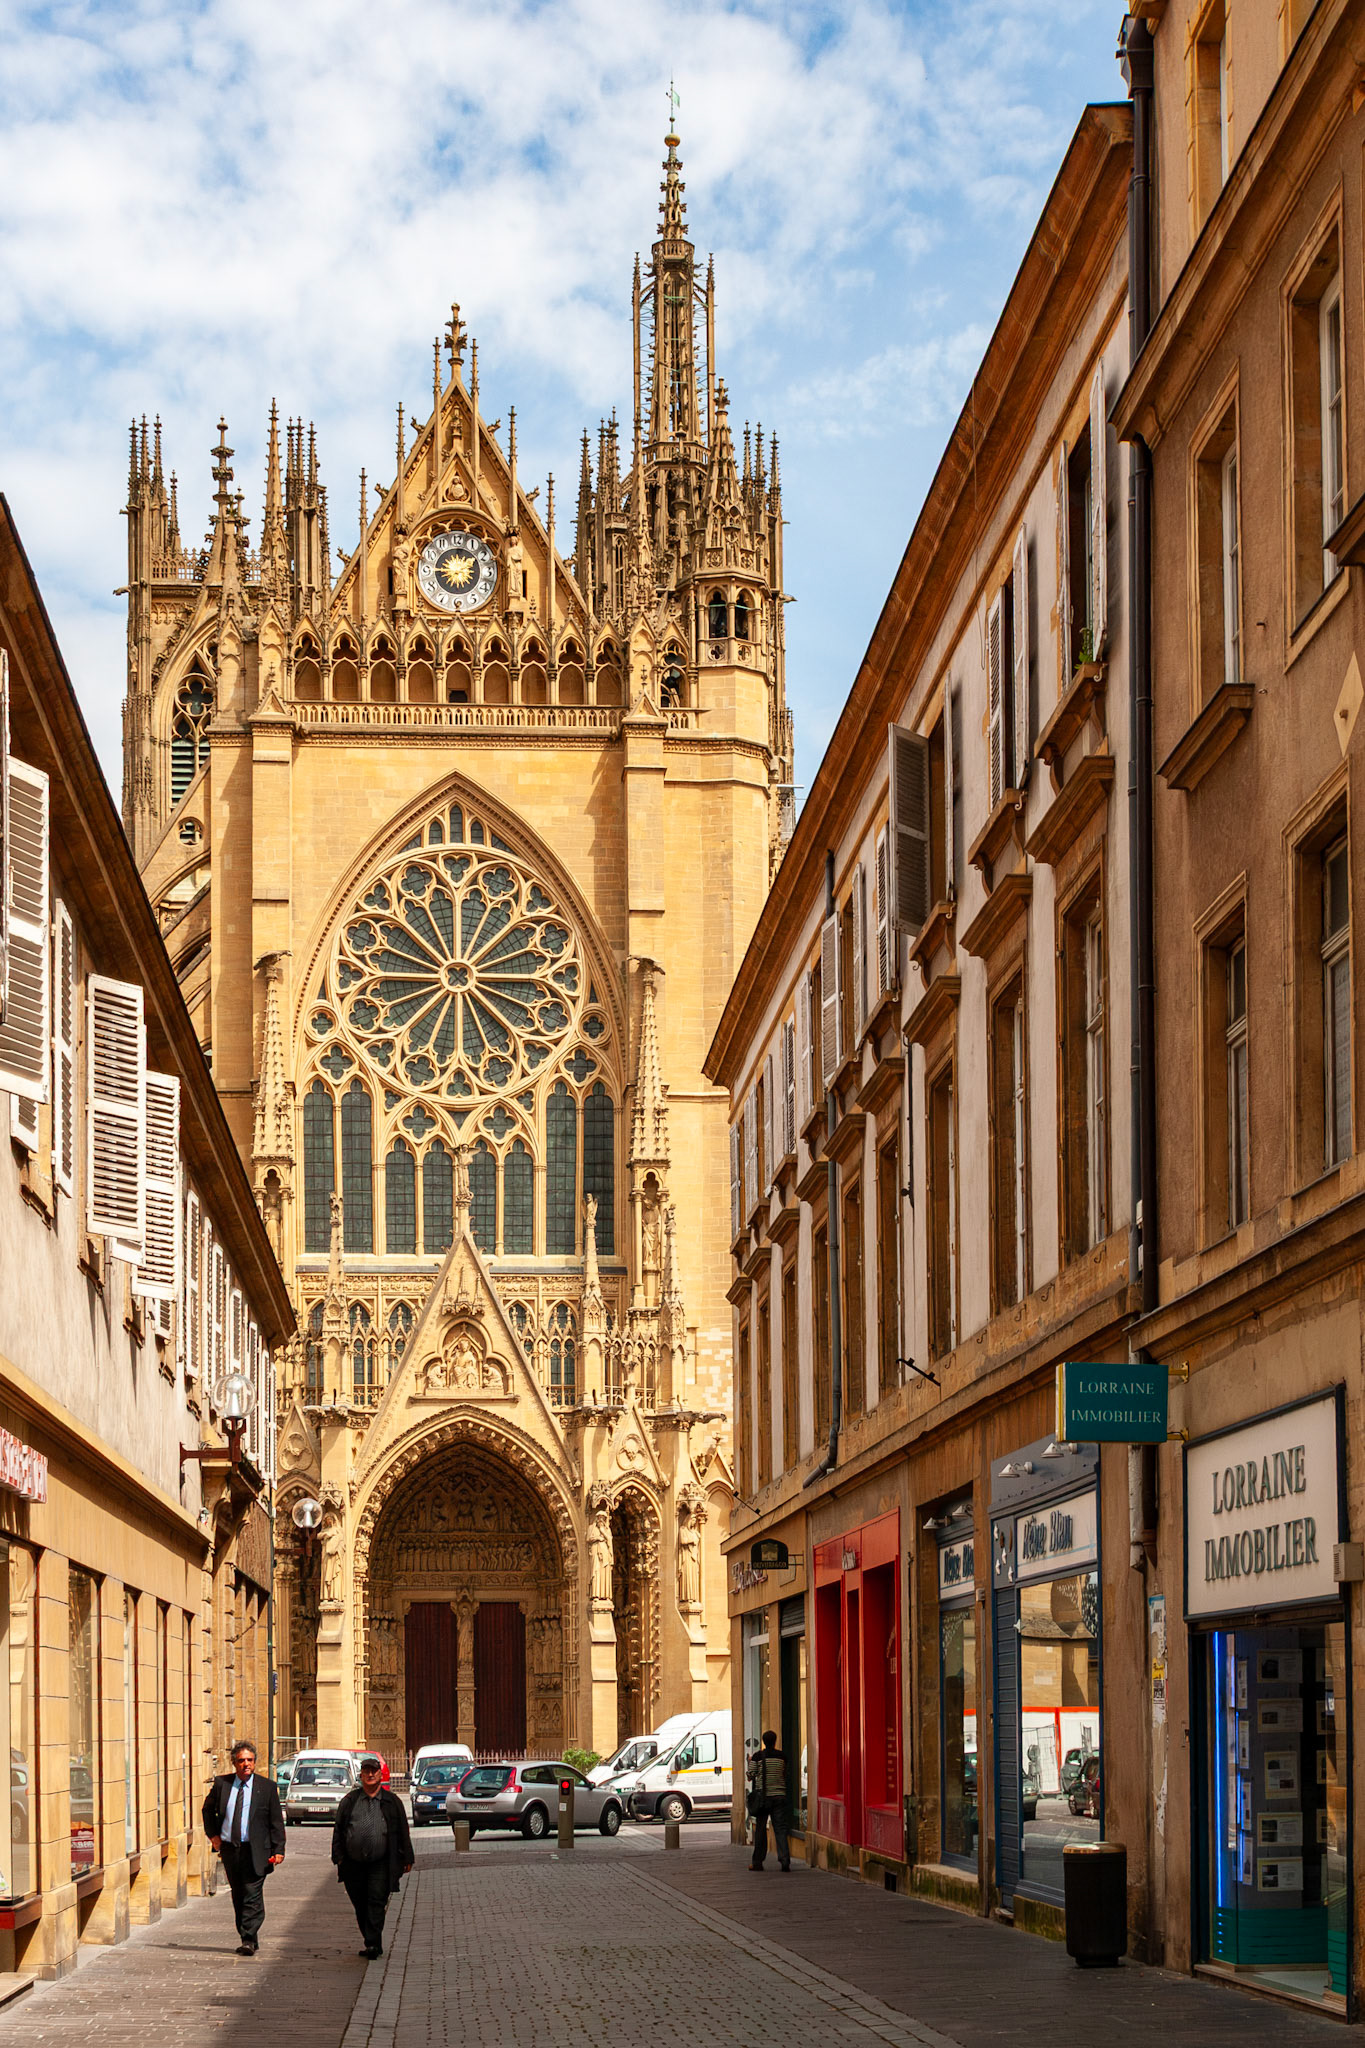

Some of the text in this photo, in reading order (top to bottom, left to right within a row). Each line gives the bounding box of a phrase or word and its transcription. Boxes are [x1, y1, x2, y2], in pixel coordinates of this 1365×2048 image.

[439, 539, 446, 548] 11
[453, 535, 462, 545] 12
[427, 550, 437, 561] 10
[480, 551, 488, 562] 2
[422, 565, 431, 575] 9
[485, 567, 493, 577] 3
[427, 581, 436, 592] 8
[479, 582, 489, 592] 4
[438, 593, 445, 605] 7
[470, 594, 477, 604] 5
[1079, 1381, 1155, 1395] LORRAINE
[1071, 1409, 1162, 1423] IMMOBILIER
[1211, 1444, 1307, 1515] LORRAINE
[1050, 1510, 1073, 1552] Bleu
[1204, 1516, 1320, 1582] IMMOBILIER
